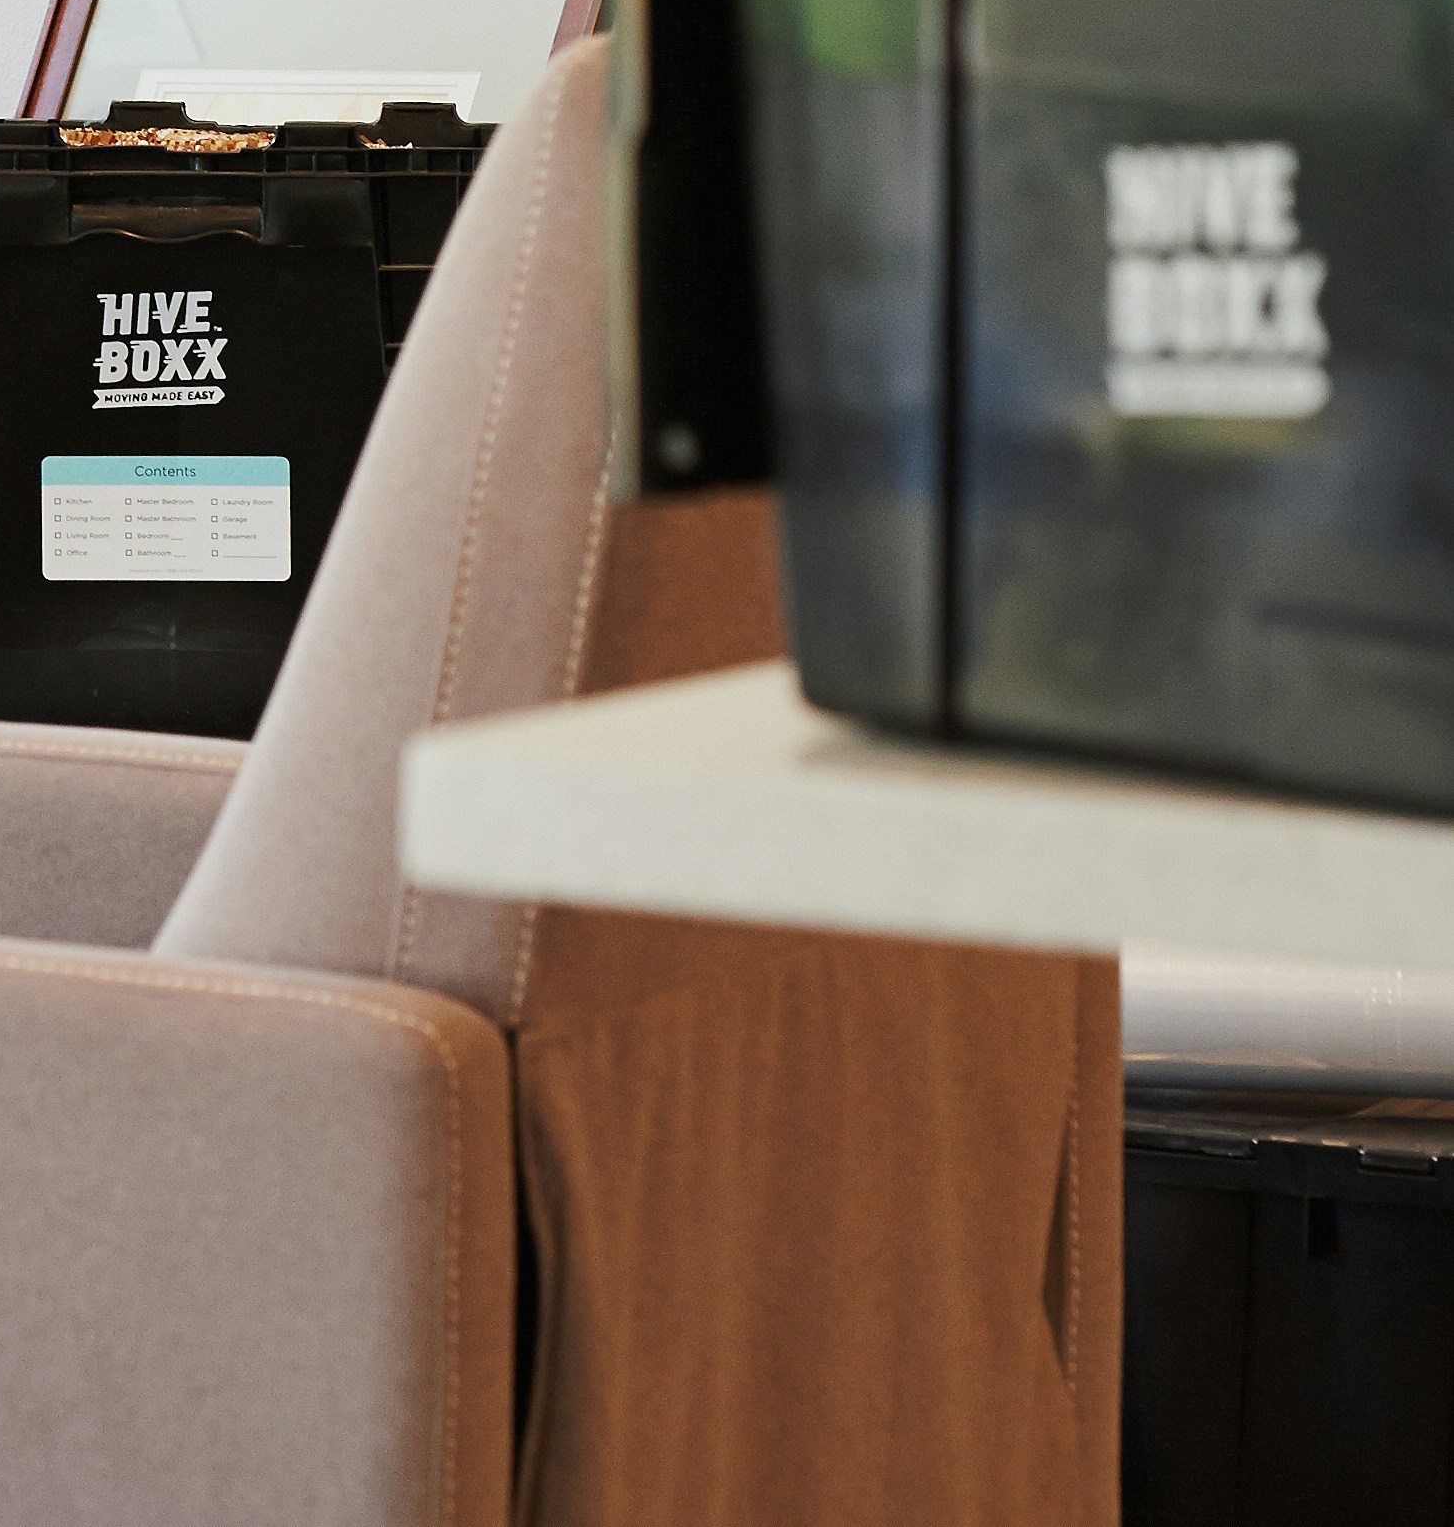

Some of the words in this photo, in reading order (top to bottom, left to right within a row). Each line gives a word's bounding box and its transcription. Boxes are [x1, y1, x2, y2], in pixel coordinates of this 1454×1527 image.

[96, 290, 213, 336] HIVE
[92, 338, 229, 384] BOXX
[104, 392, 148, 403] MOVING
[151, 391, 183, 402] MADE
[187, 390, 216, 401] EASY
[134, 465, 197, 478] Contents
[65, 498, 93, 506] Kitchen
[222, 498, 251, 507] Laundry
[65, 515, 89, 523] Dining
[66, 532, 88, 540] Living
[136, 532, 170, 540] Bedroom
[66, 549, 88, 557] Office
